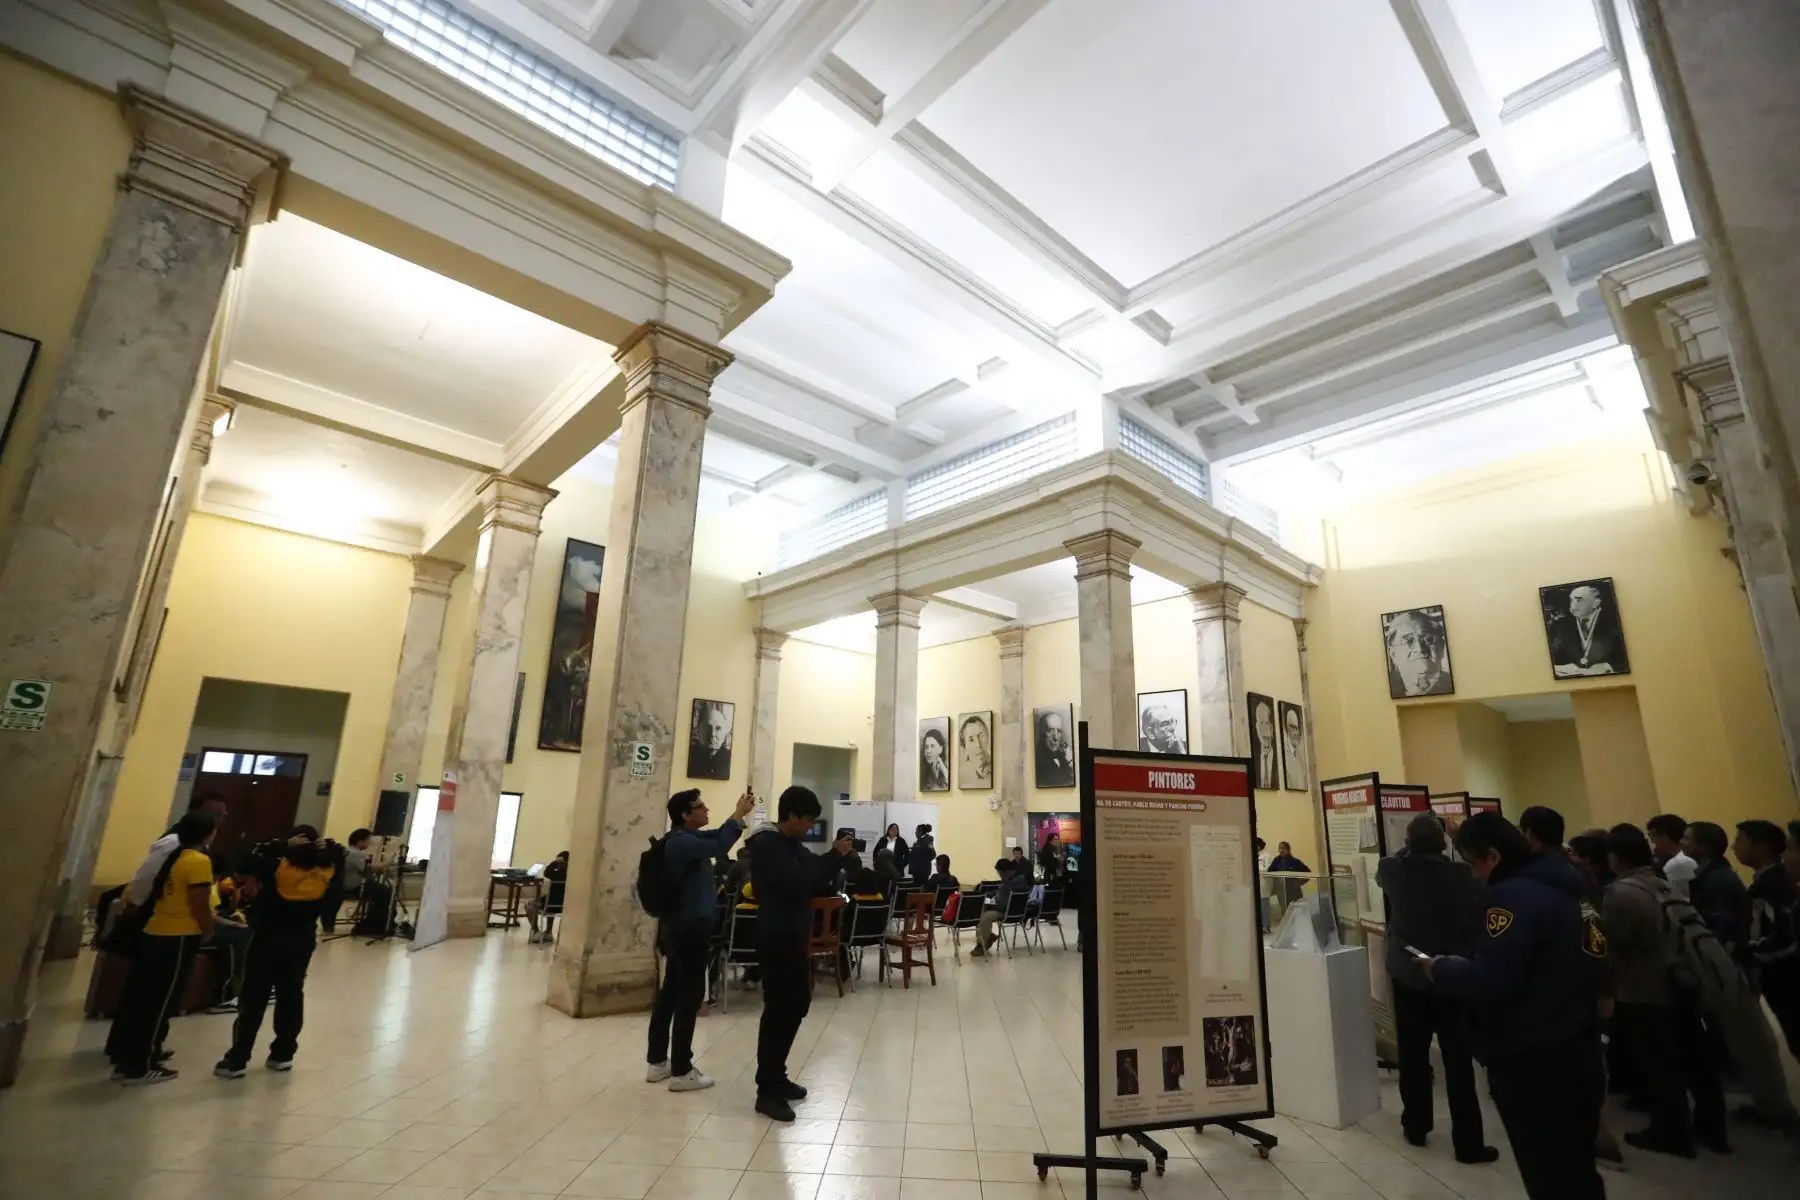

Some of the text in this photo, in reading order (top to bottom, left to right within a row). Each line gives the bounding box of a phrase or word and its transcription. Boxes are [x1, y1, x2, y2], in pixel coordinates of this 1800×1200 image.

[11, 682, 46, 709] S
[637, 745, 650, 761] S
[395, 773, 403, 783] S
[1148, 771, 1195, 790] PINTORES
[758, 796, 764, 804] S
[1488, 913, 1508, 931] SP
